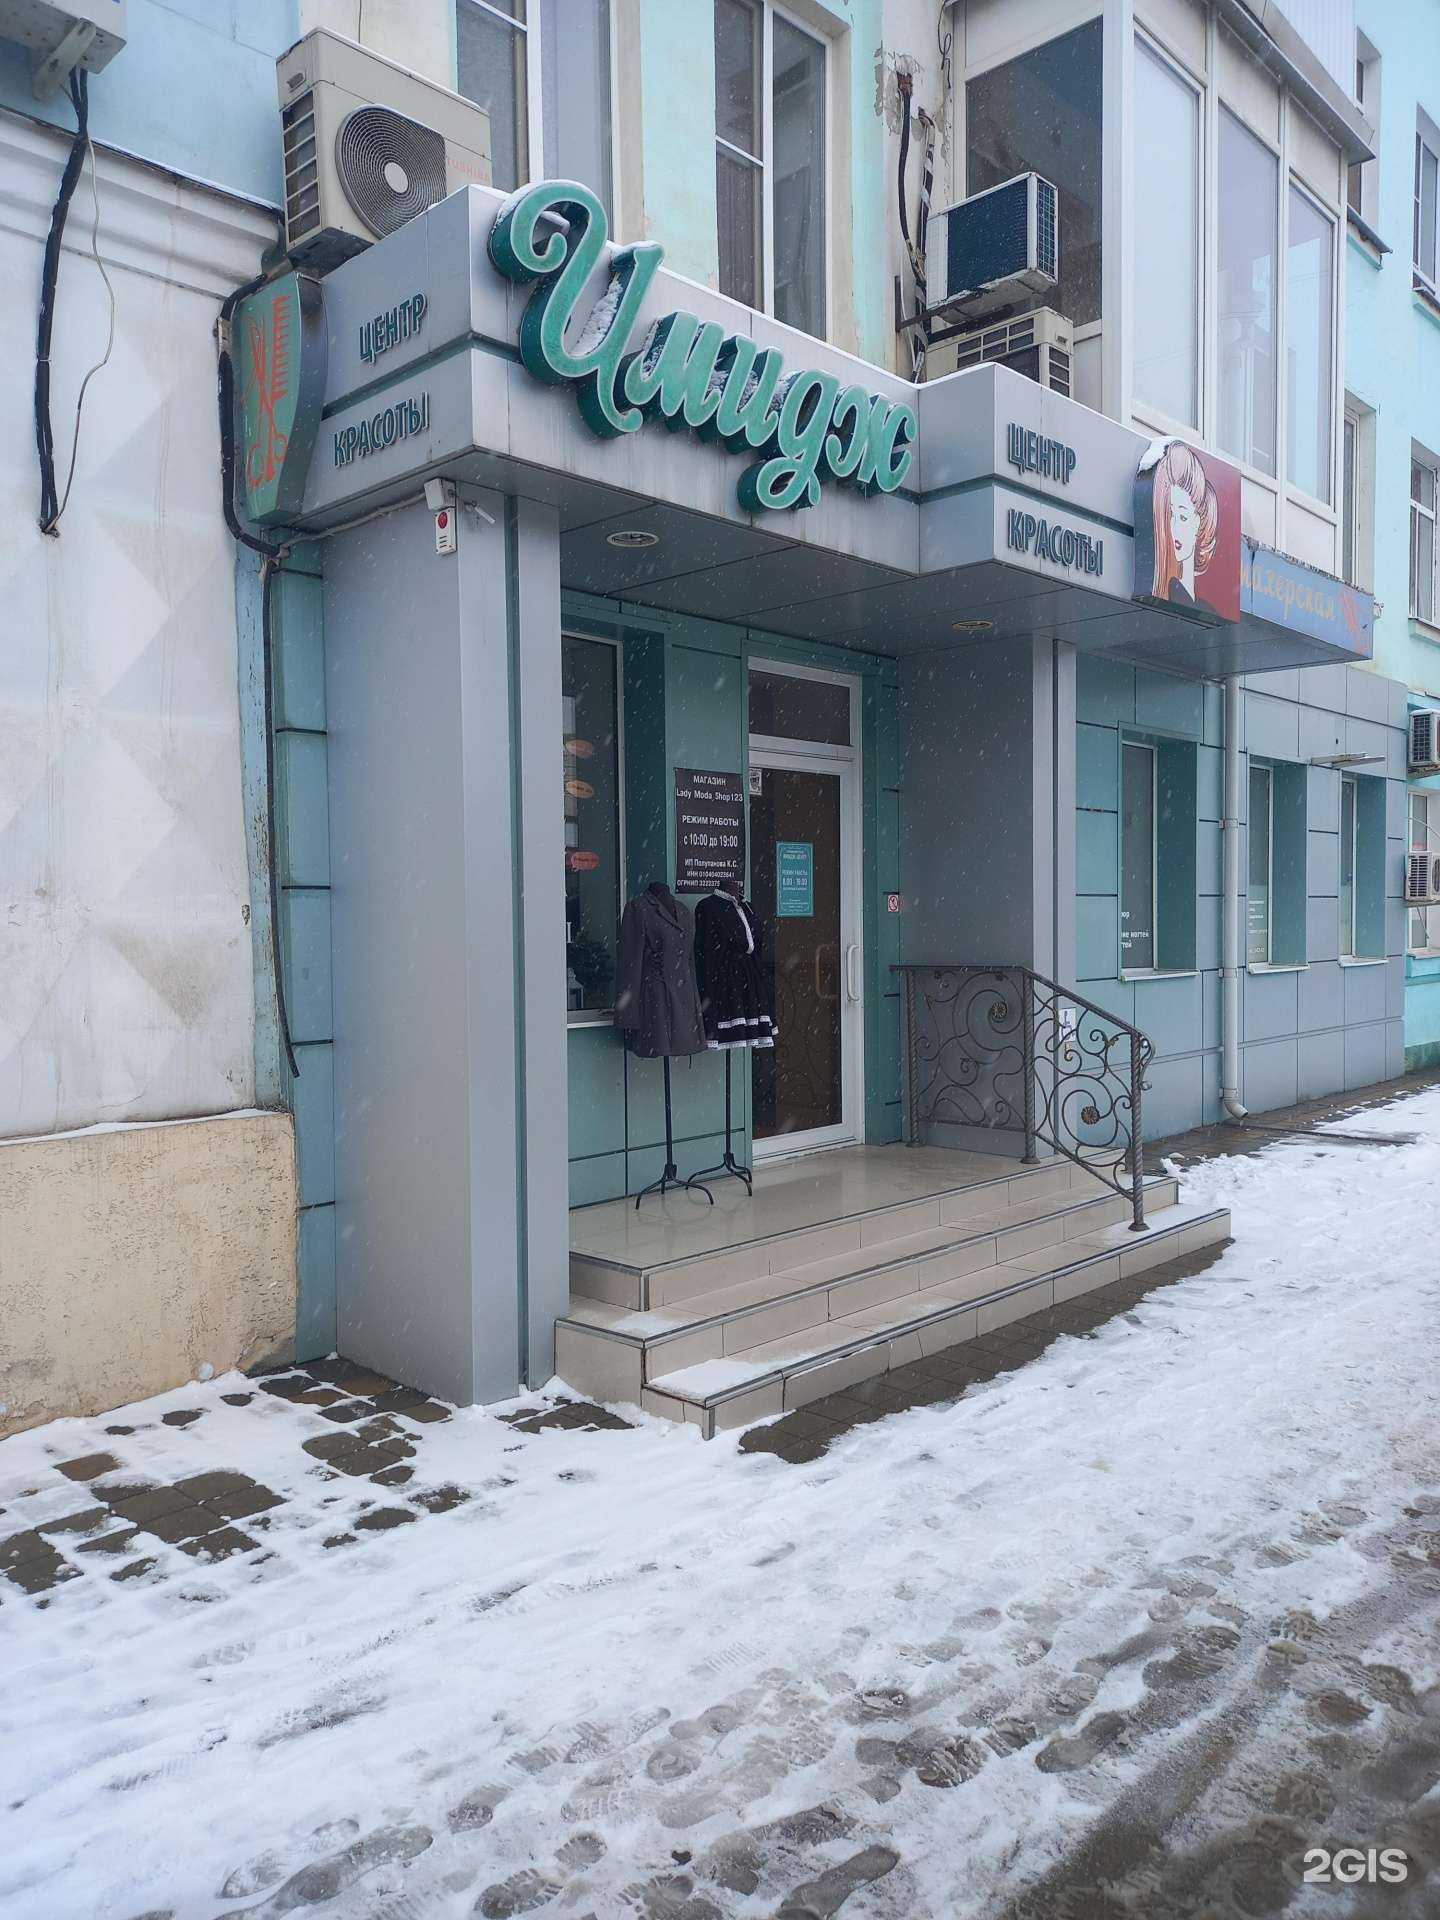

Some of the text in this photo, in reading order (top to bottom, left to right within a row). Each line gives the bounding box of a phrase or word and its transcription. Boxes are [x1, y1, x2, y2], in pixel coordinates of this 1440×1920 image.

[359, 292, 427, 364] ЦЕНТР
[333, 391, 430, 468] КРАСОТЫ
[1008, 422, 1077, 485] ЦЕНТР
[1008, 508, 1104, 577] КРАСОТЫ
[693, 775, 726, 786] МАГАЗИН
[676, 787, 692, 800] Lady
[682, 814, 739, 827] РЕЖИМ РАБОТЫ
[690, 833, 708, 846] 10:00
[709, 837, 718, 848] до
[719, 835, 738, 848] 19:00
[685, 858, 693, 867] ИП
[687, 870, 698, 878] ИНН
